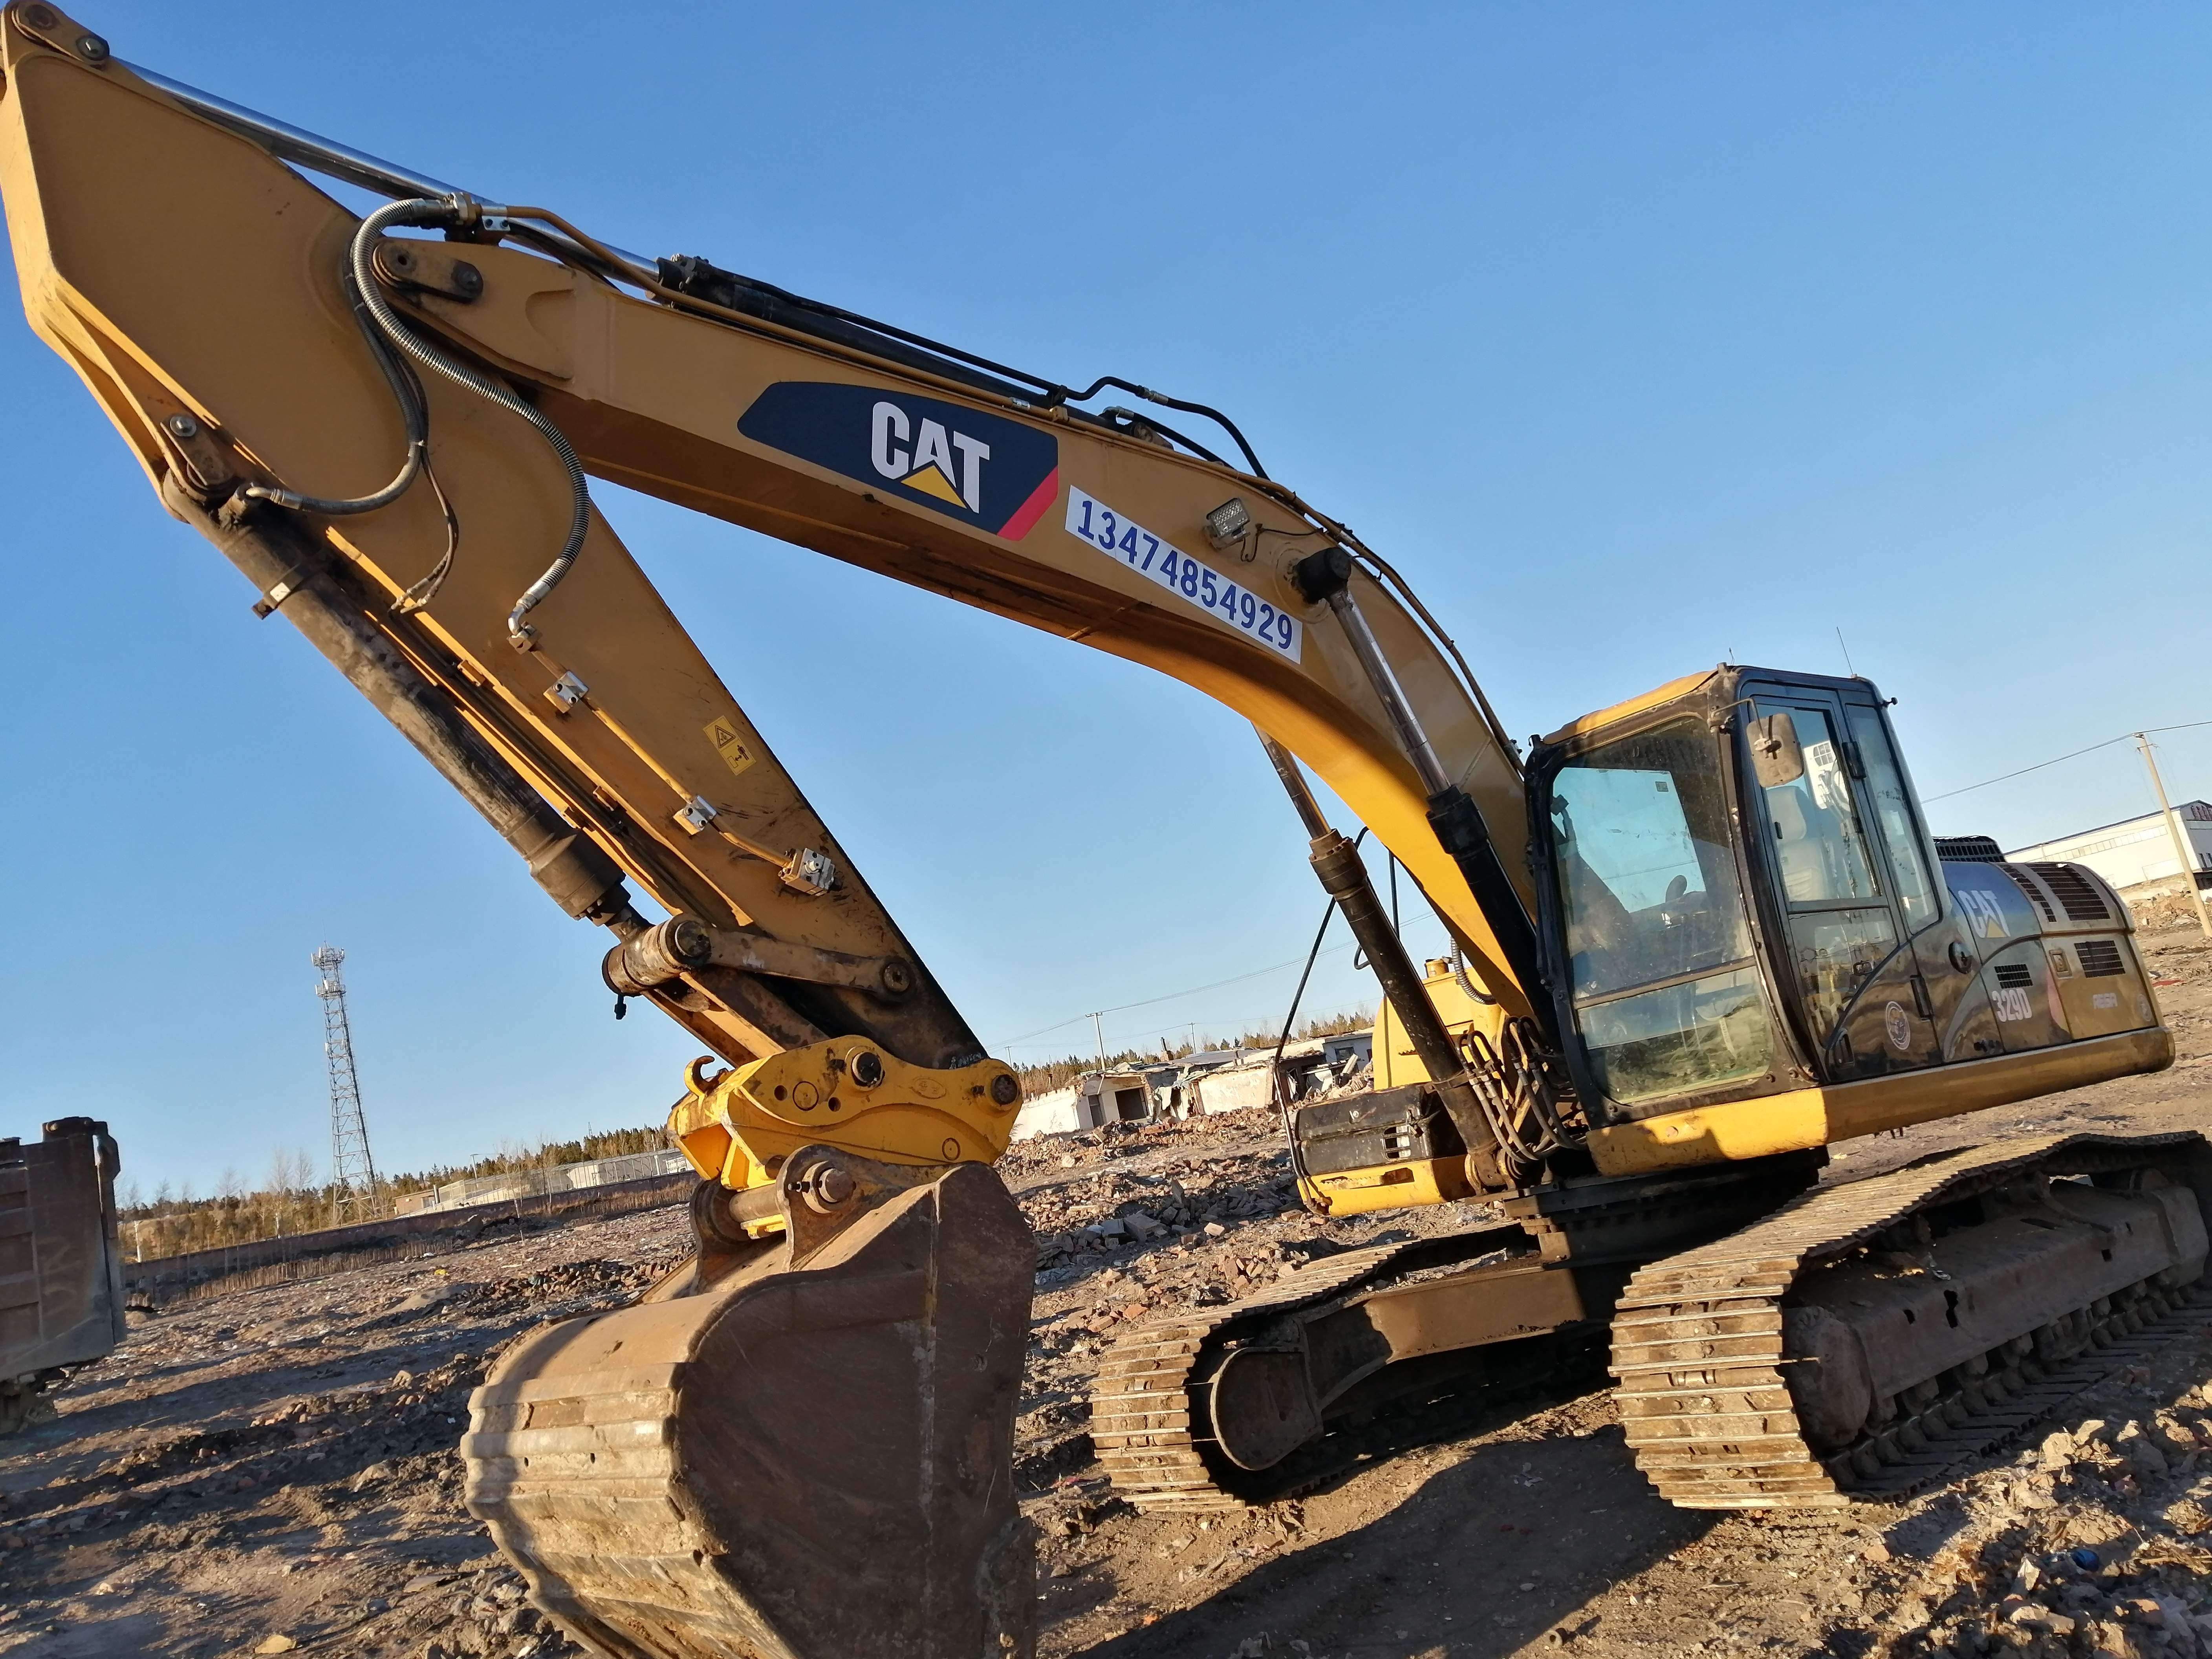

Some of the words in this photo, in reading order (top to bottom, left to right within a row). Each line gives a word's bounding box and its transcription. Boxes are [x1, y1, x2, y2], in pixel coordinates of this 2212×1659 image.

[871, 401, 990, 514] CAT
[1077, 500, 1293, 650] 13474854929
[1957, 890, 2011, 938] CAT
[1992, 988, 2033, 1022] 329D
